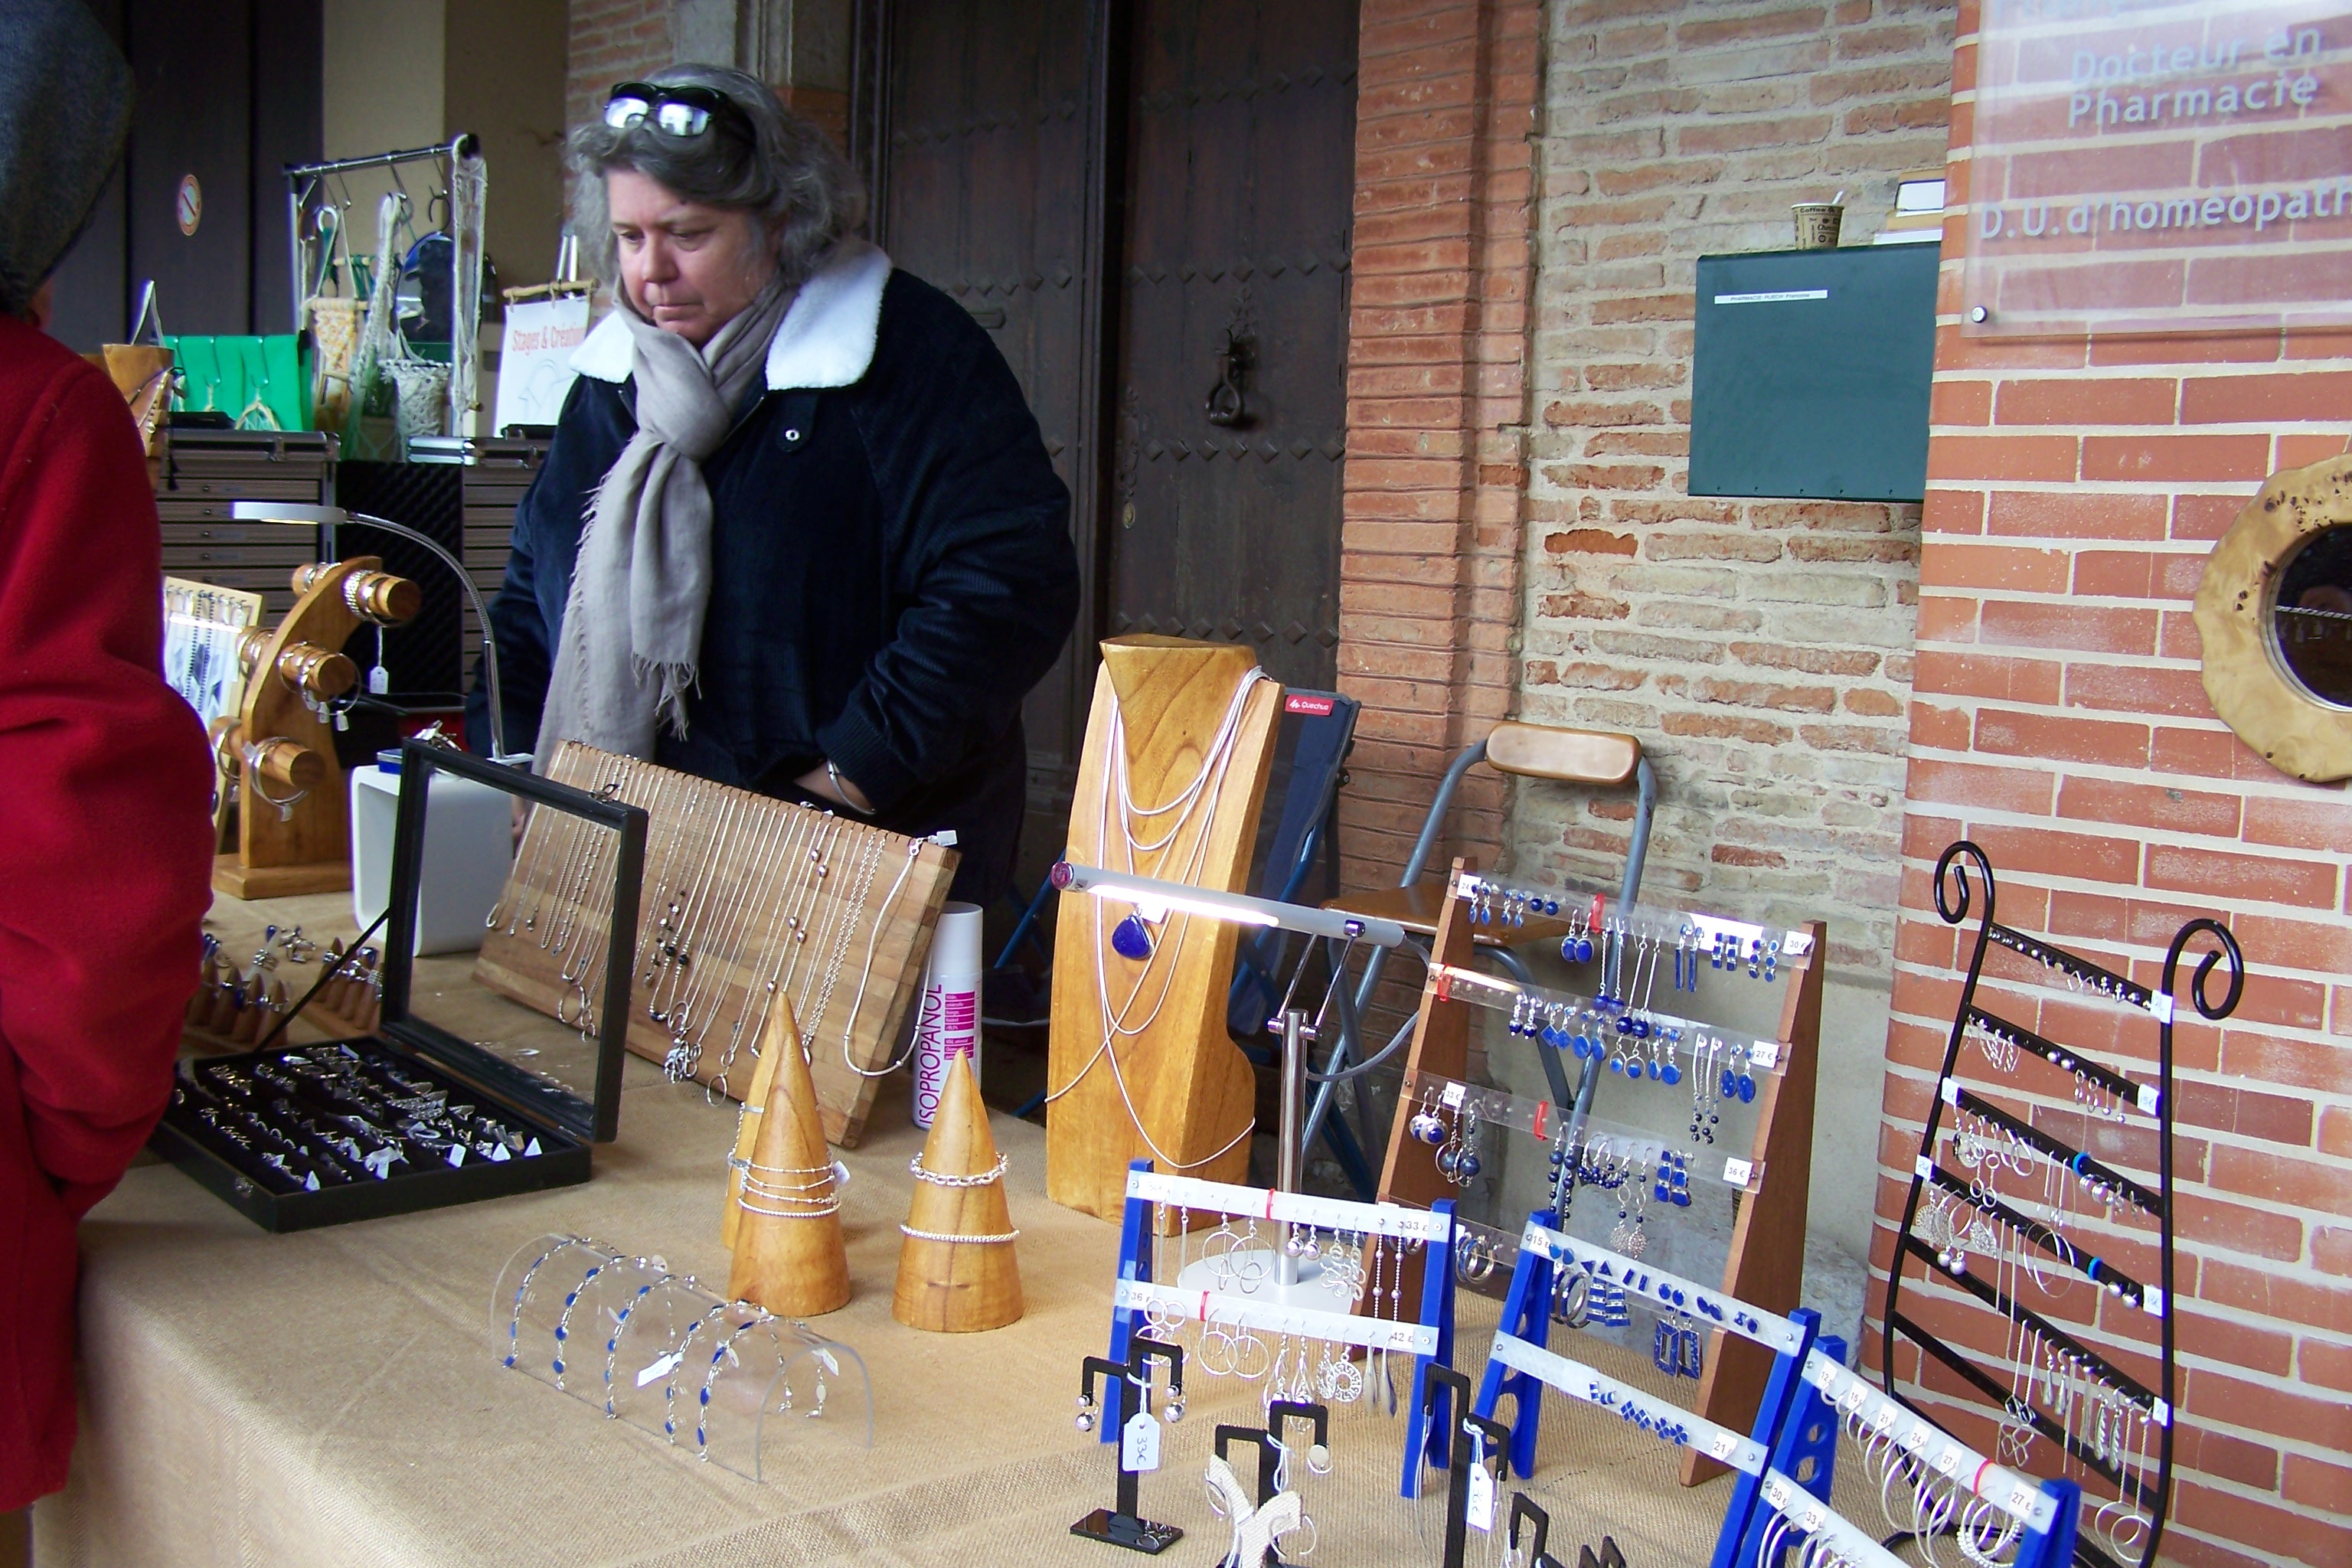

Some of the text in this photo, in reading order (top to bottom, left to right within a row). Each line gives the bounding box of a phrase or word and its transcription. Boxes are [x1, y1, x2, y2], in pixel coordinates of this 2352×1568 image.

[2071, 27, 2321, 83] Docteur en
[2068, 69, 2319, 129] Pharmacie
[1302, 701, 1329, 710] Quechua
[1789, 940, 1799, 949] 30
[919, 984, 942, 1124] ISOPROPANOL
[1728, 1167, 1737, 1175] 36
[1406, 1220, 1419, 1230] 33
[1533, 1235, 1544, 1246] 15
[1131, 1292, 1143, 1302] 36
[1391, 1331, 1405, 1342] 42
[1821, 1370, 1829, 1382] 12
[1851, 1392, 1859, 1403] 15
[1880, 1413, 1889, 1424] 21
[1911, 1432, 1922, 1444] 24
[1713, 1441, 1726, 1454] 21
[1942, 1455, 1952, 1465] 27
[1772, 1488, 1782, 1501] 30
[2011, 1491, 2025, 1505] 27
[1806, 1511, 1817, 1525] 33
